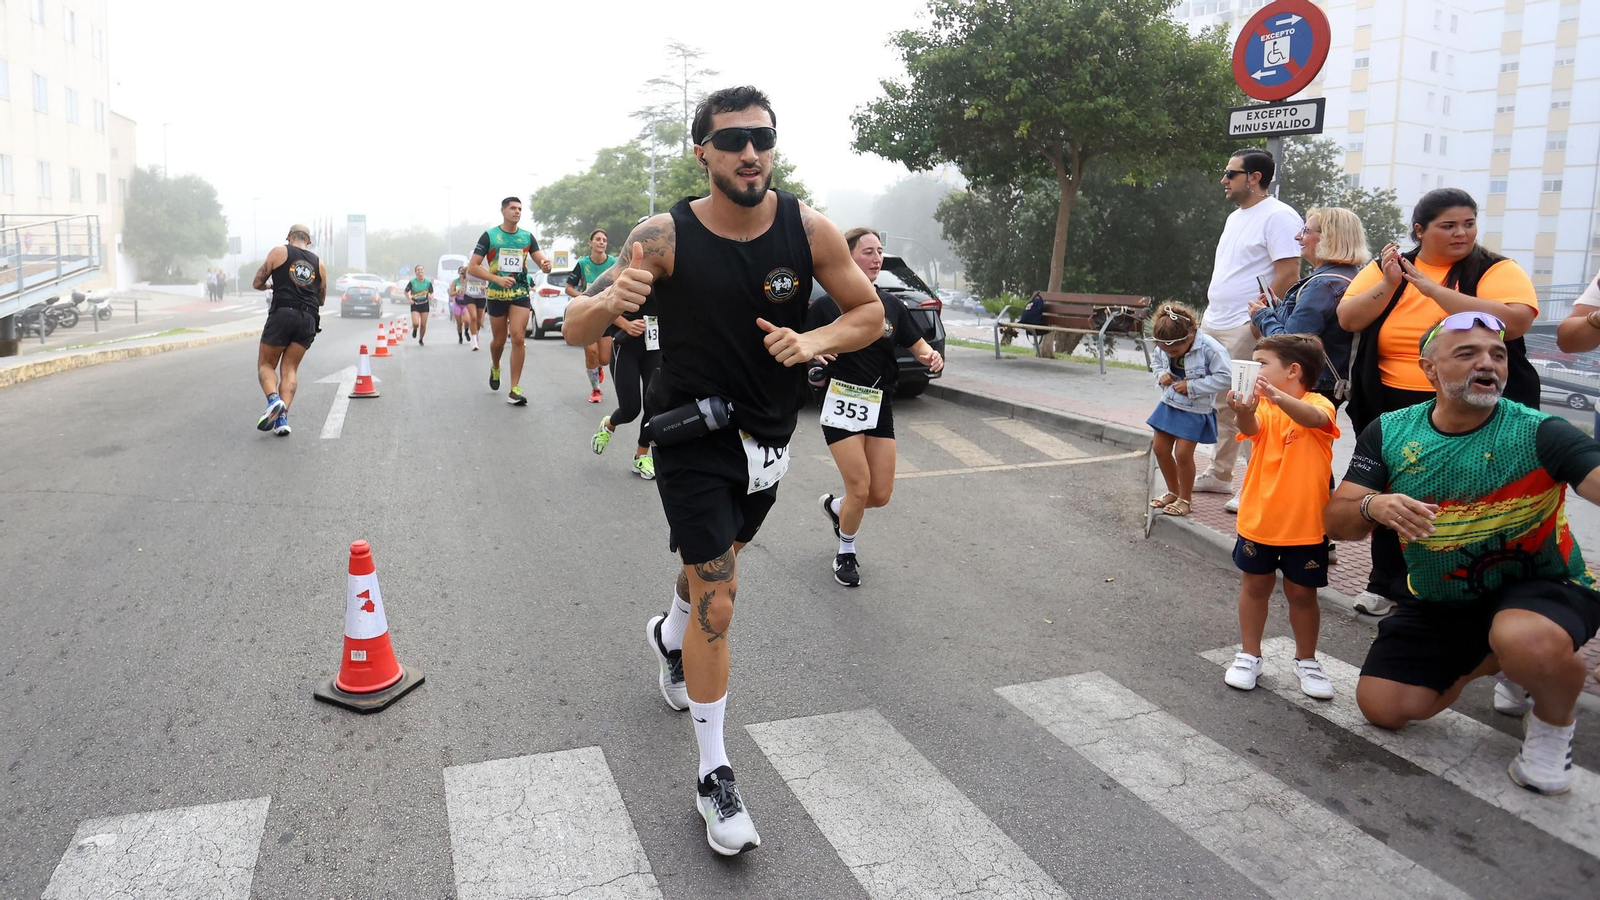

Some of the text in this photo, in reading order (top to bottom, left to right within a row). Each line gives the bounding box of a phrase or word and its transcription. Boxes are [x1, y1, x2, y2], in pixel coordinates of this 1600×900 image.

[1261, 28, 1295, 41] EXCEPTO
[1246, 107, 1298, 120] EXCEPTO
[1233, 118, 1310, 133] MINUSVALIDO
[504, 257, 520, 266] 162
[833, 399, 869, 421] 353
